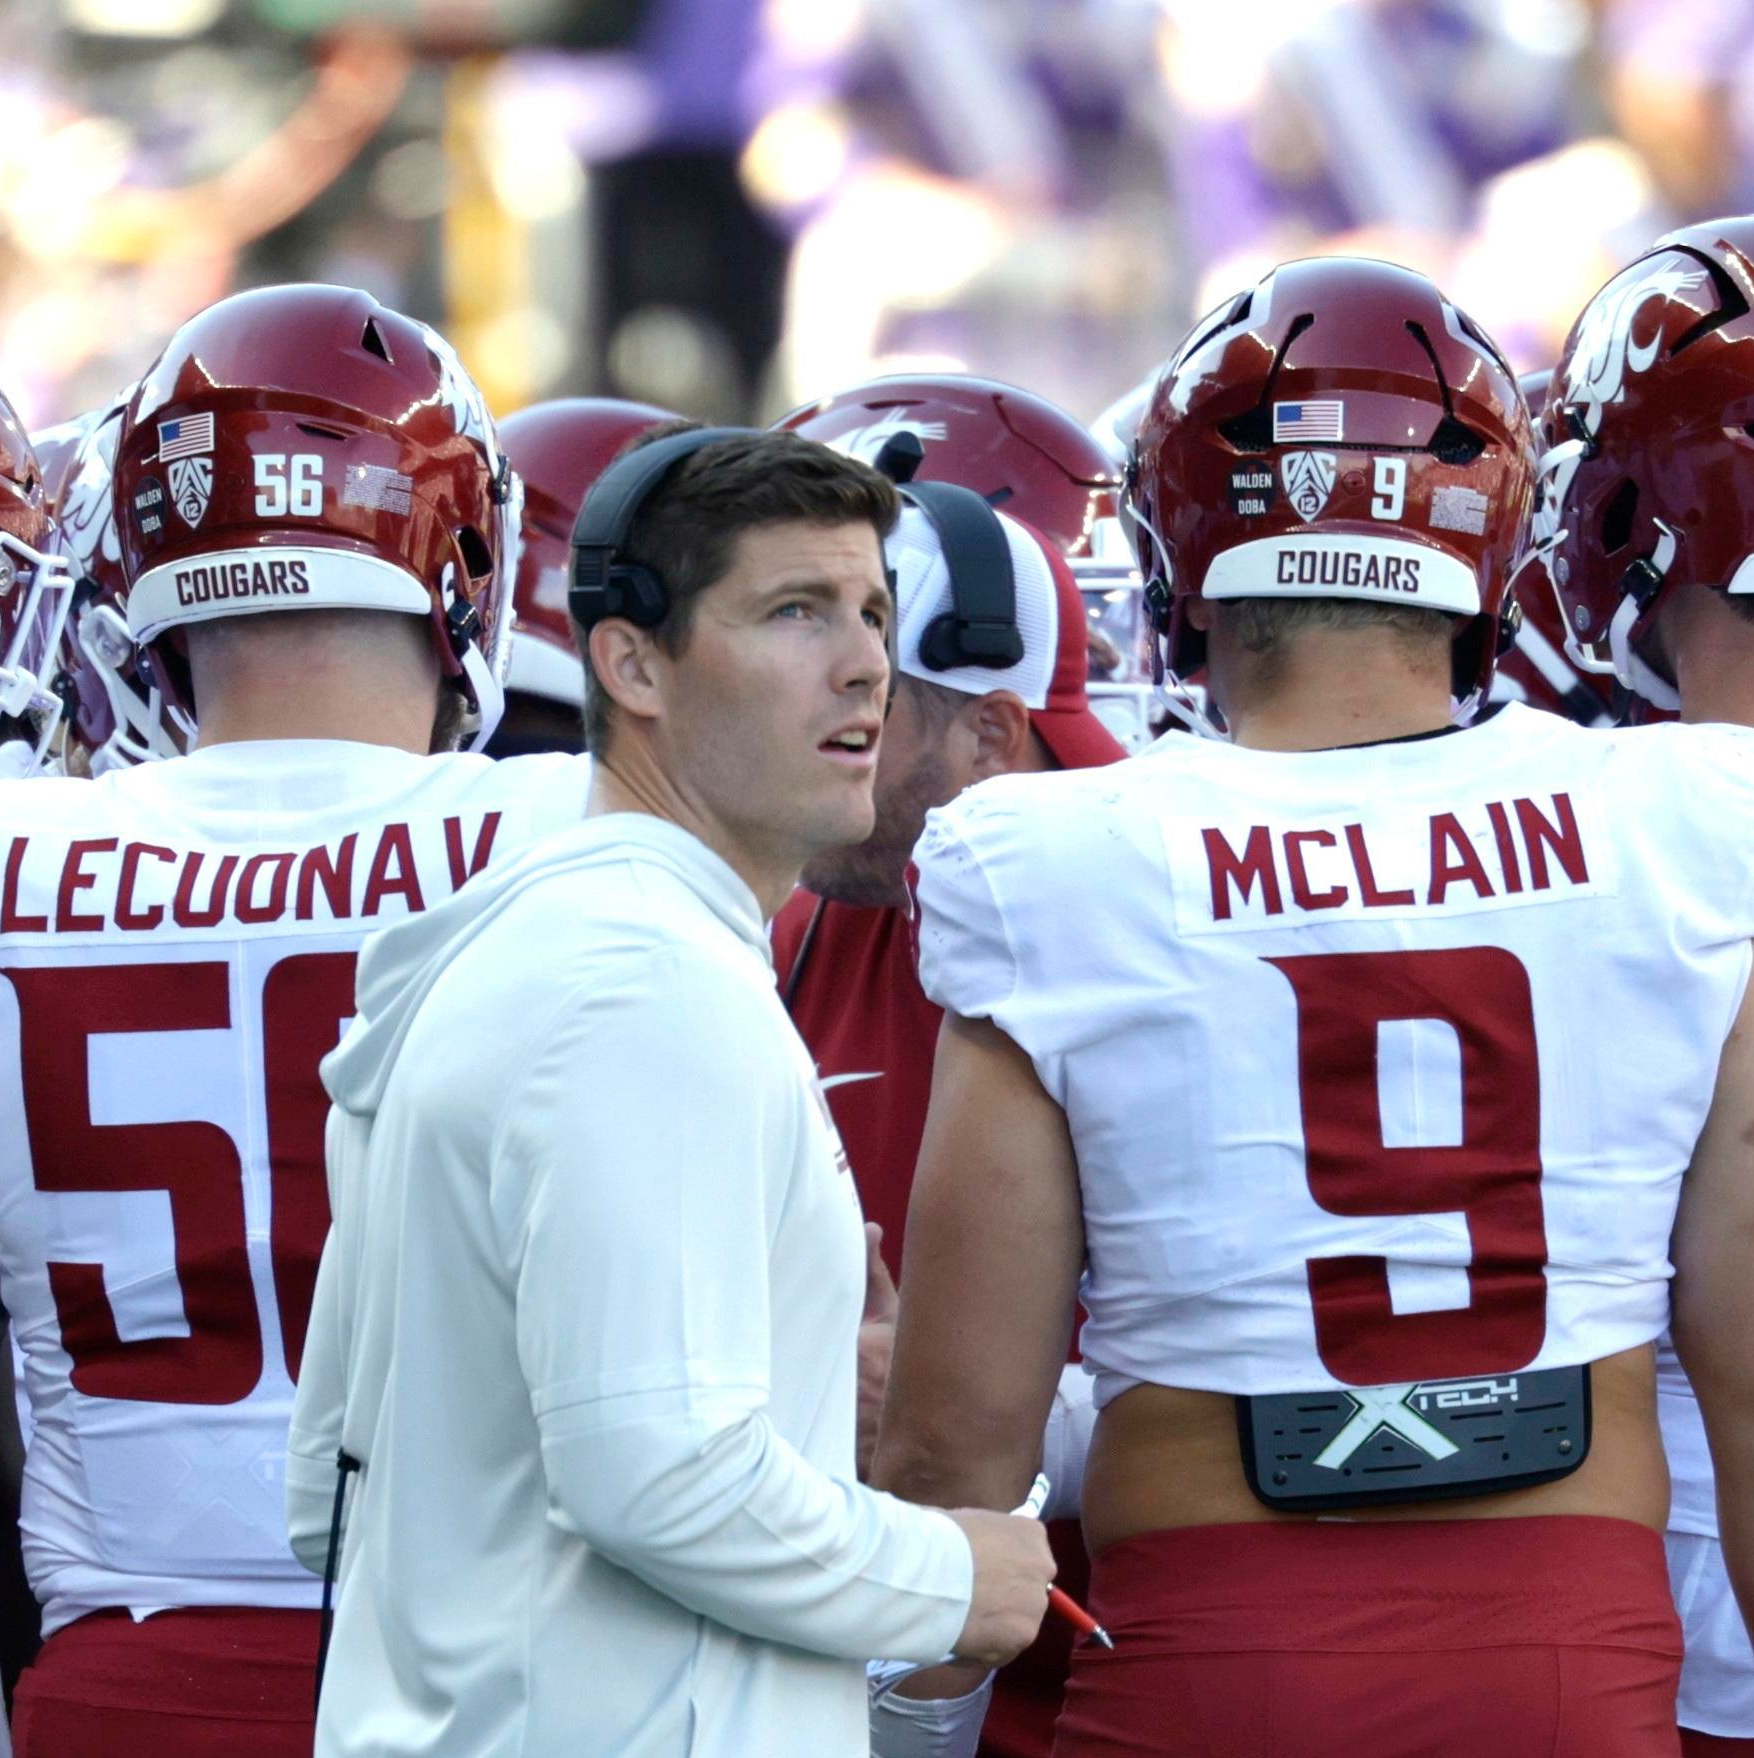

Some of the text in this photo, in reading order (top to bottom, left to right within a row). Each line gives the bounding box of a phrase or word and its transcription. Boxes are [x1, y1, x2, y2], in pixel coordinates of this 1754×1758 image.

[253, 454, 324, 517] 56
[1232, 473, 1272, 489] WALDEN
[1238, 499, 1266, 515] DOBA
[1371, 456, 1406, 520] 9
[175, 560, 310, 606] COUGARS
[1277, 550, 1421, 593] COUGARS
[0, 822, 427, 934] LECUONA
[1200, 792, 1590, 921] MCLAIN
[1258, 945, 1549, 1387] 9
